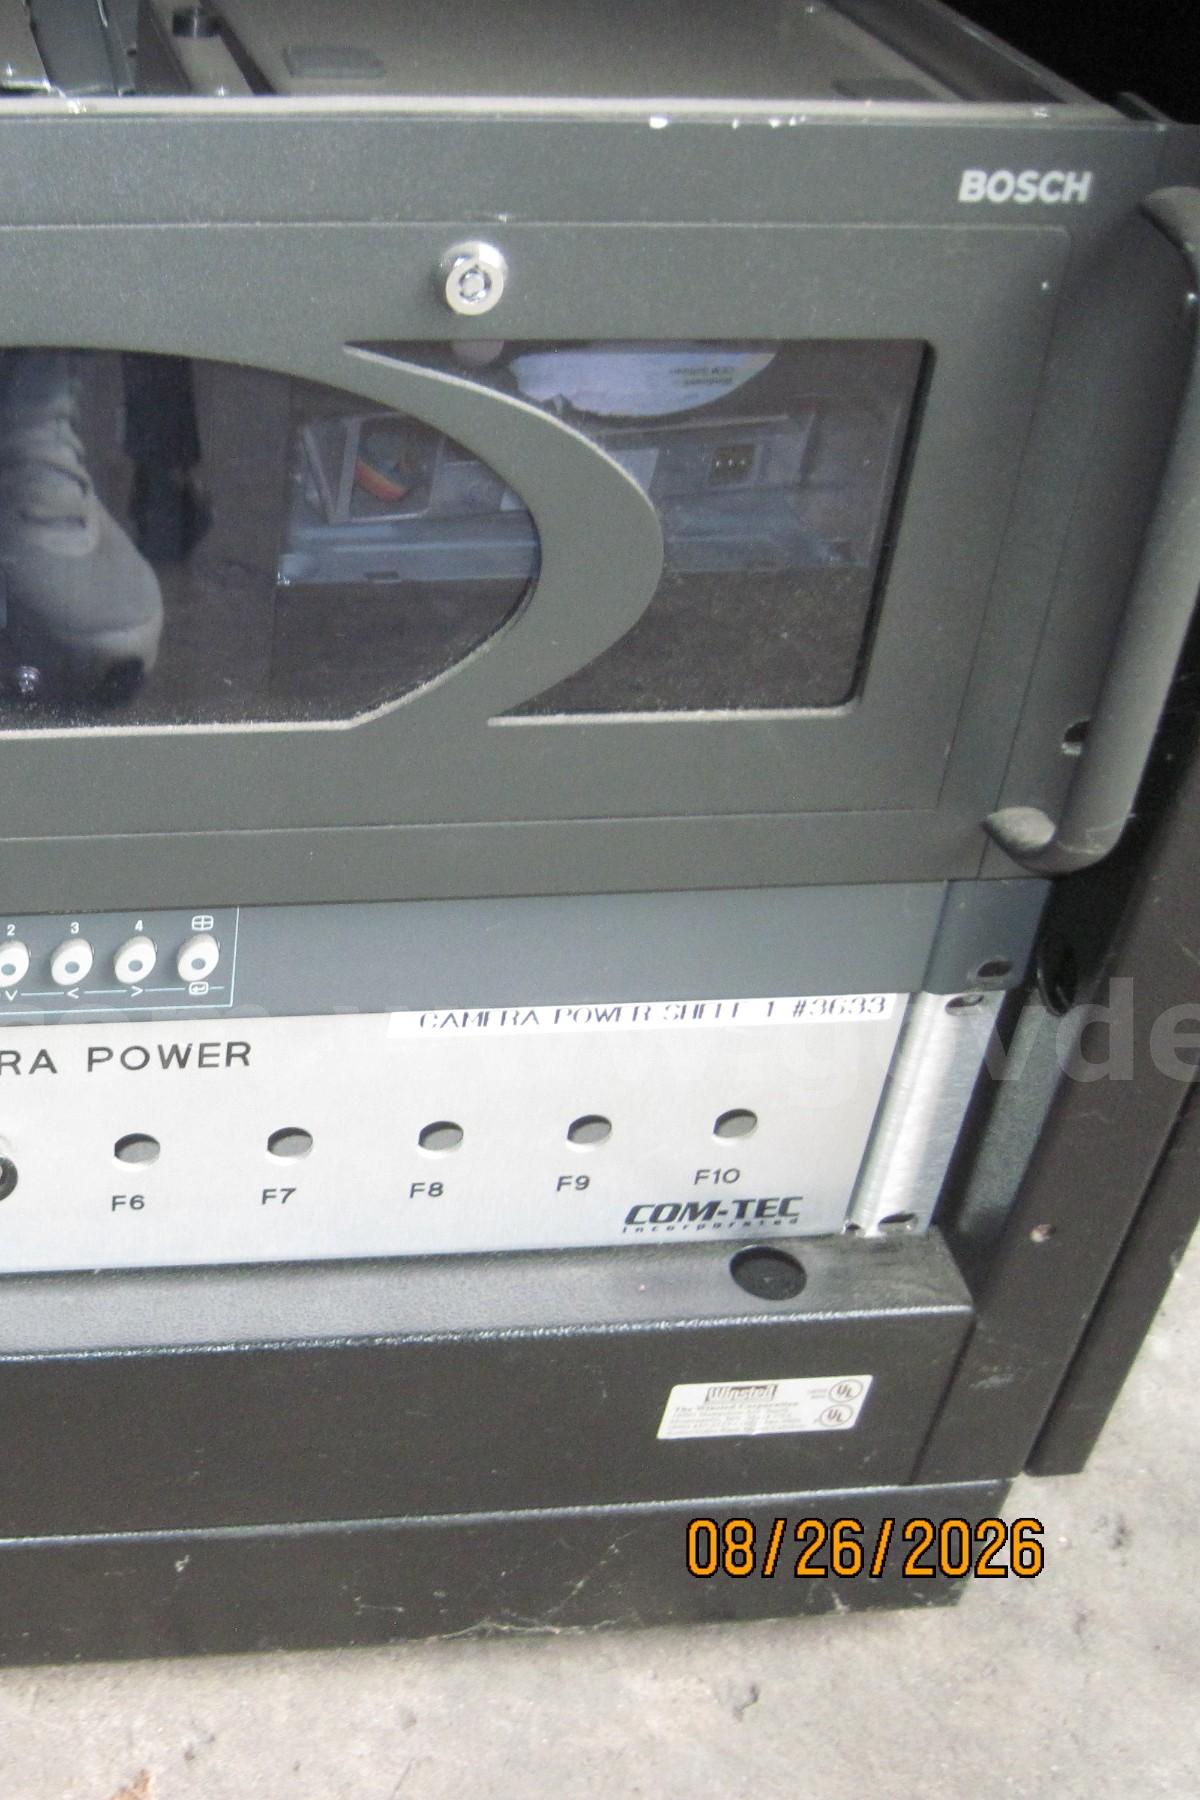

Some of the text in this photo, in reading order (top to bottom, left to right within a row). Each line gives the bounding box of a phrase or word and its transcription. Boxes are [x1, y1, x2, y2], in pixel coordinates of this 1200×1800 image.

[958, 169, 1094, 204] BOSCH
[6, 923, 16, 936] 2
[70, 921, 80, 934] 3
[134, 919, 144, 932] 4
[86, 1040, 253, 1073] POWER
[555, 1174, 591, 1193] F9
[693, 1168, 742, 1187] F10
[260, 1186, 298, 1206] F7
[409, 1181, 445, 1200] F8
[111, 1194, 147, 1213] F6
[623, 1196, 804, 1226] COM-TEC
